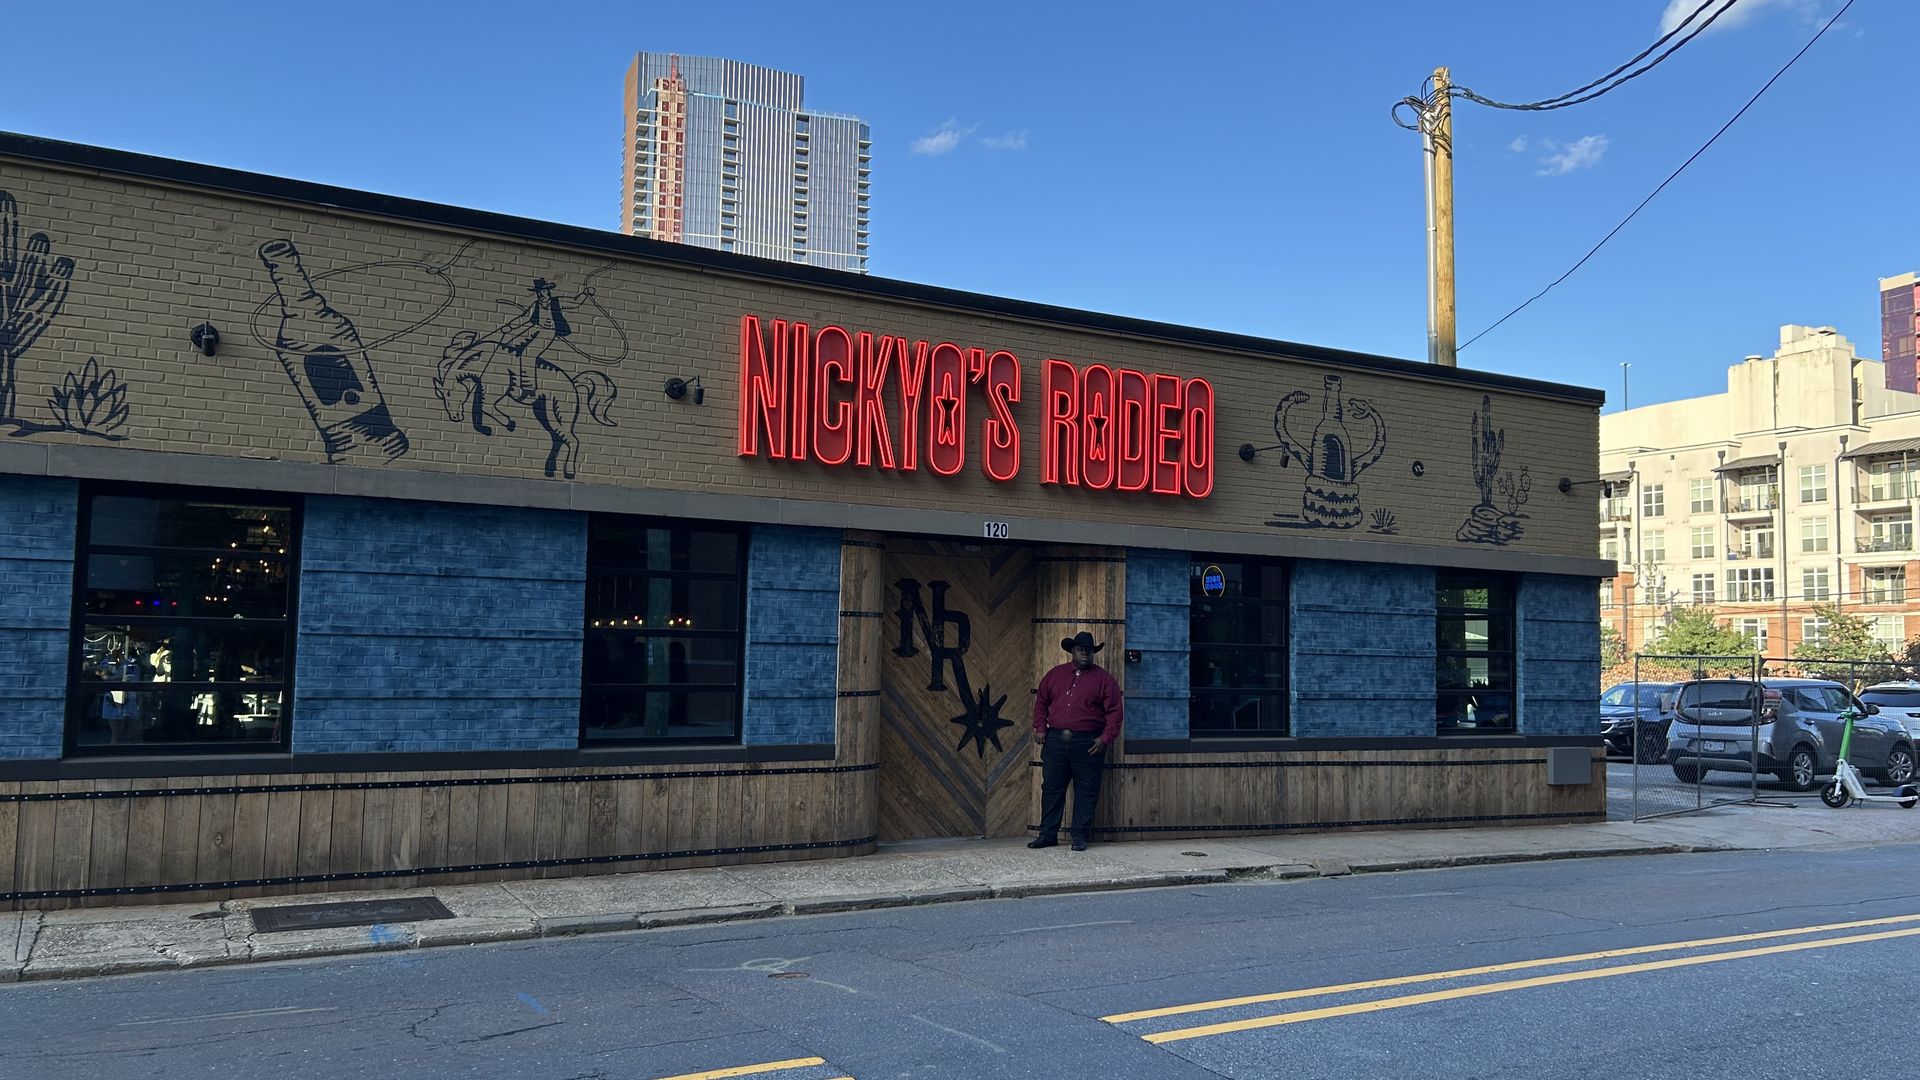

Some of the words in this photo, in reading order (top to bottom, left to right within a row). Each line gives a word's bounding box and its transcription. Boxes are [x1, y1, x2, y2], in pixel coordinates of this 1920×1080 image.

[739, 314, 1020, 481] NICKYO'S
[1041, 359, 1214, 498] RODEO
[985, 522, 1008, 538] 120
